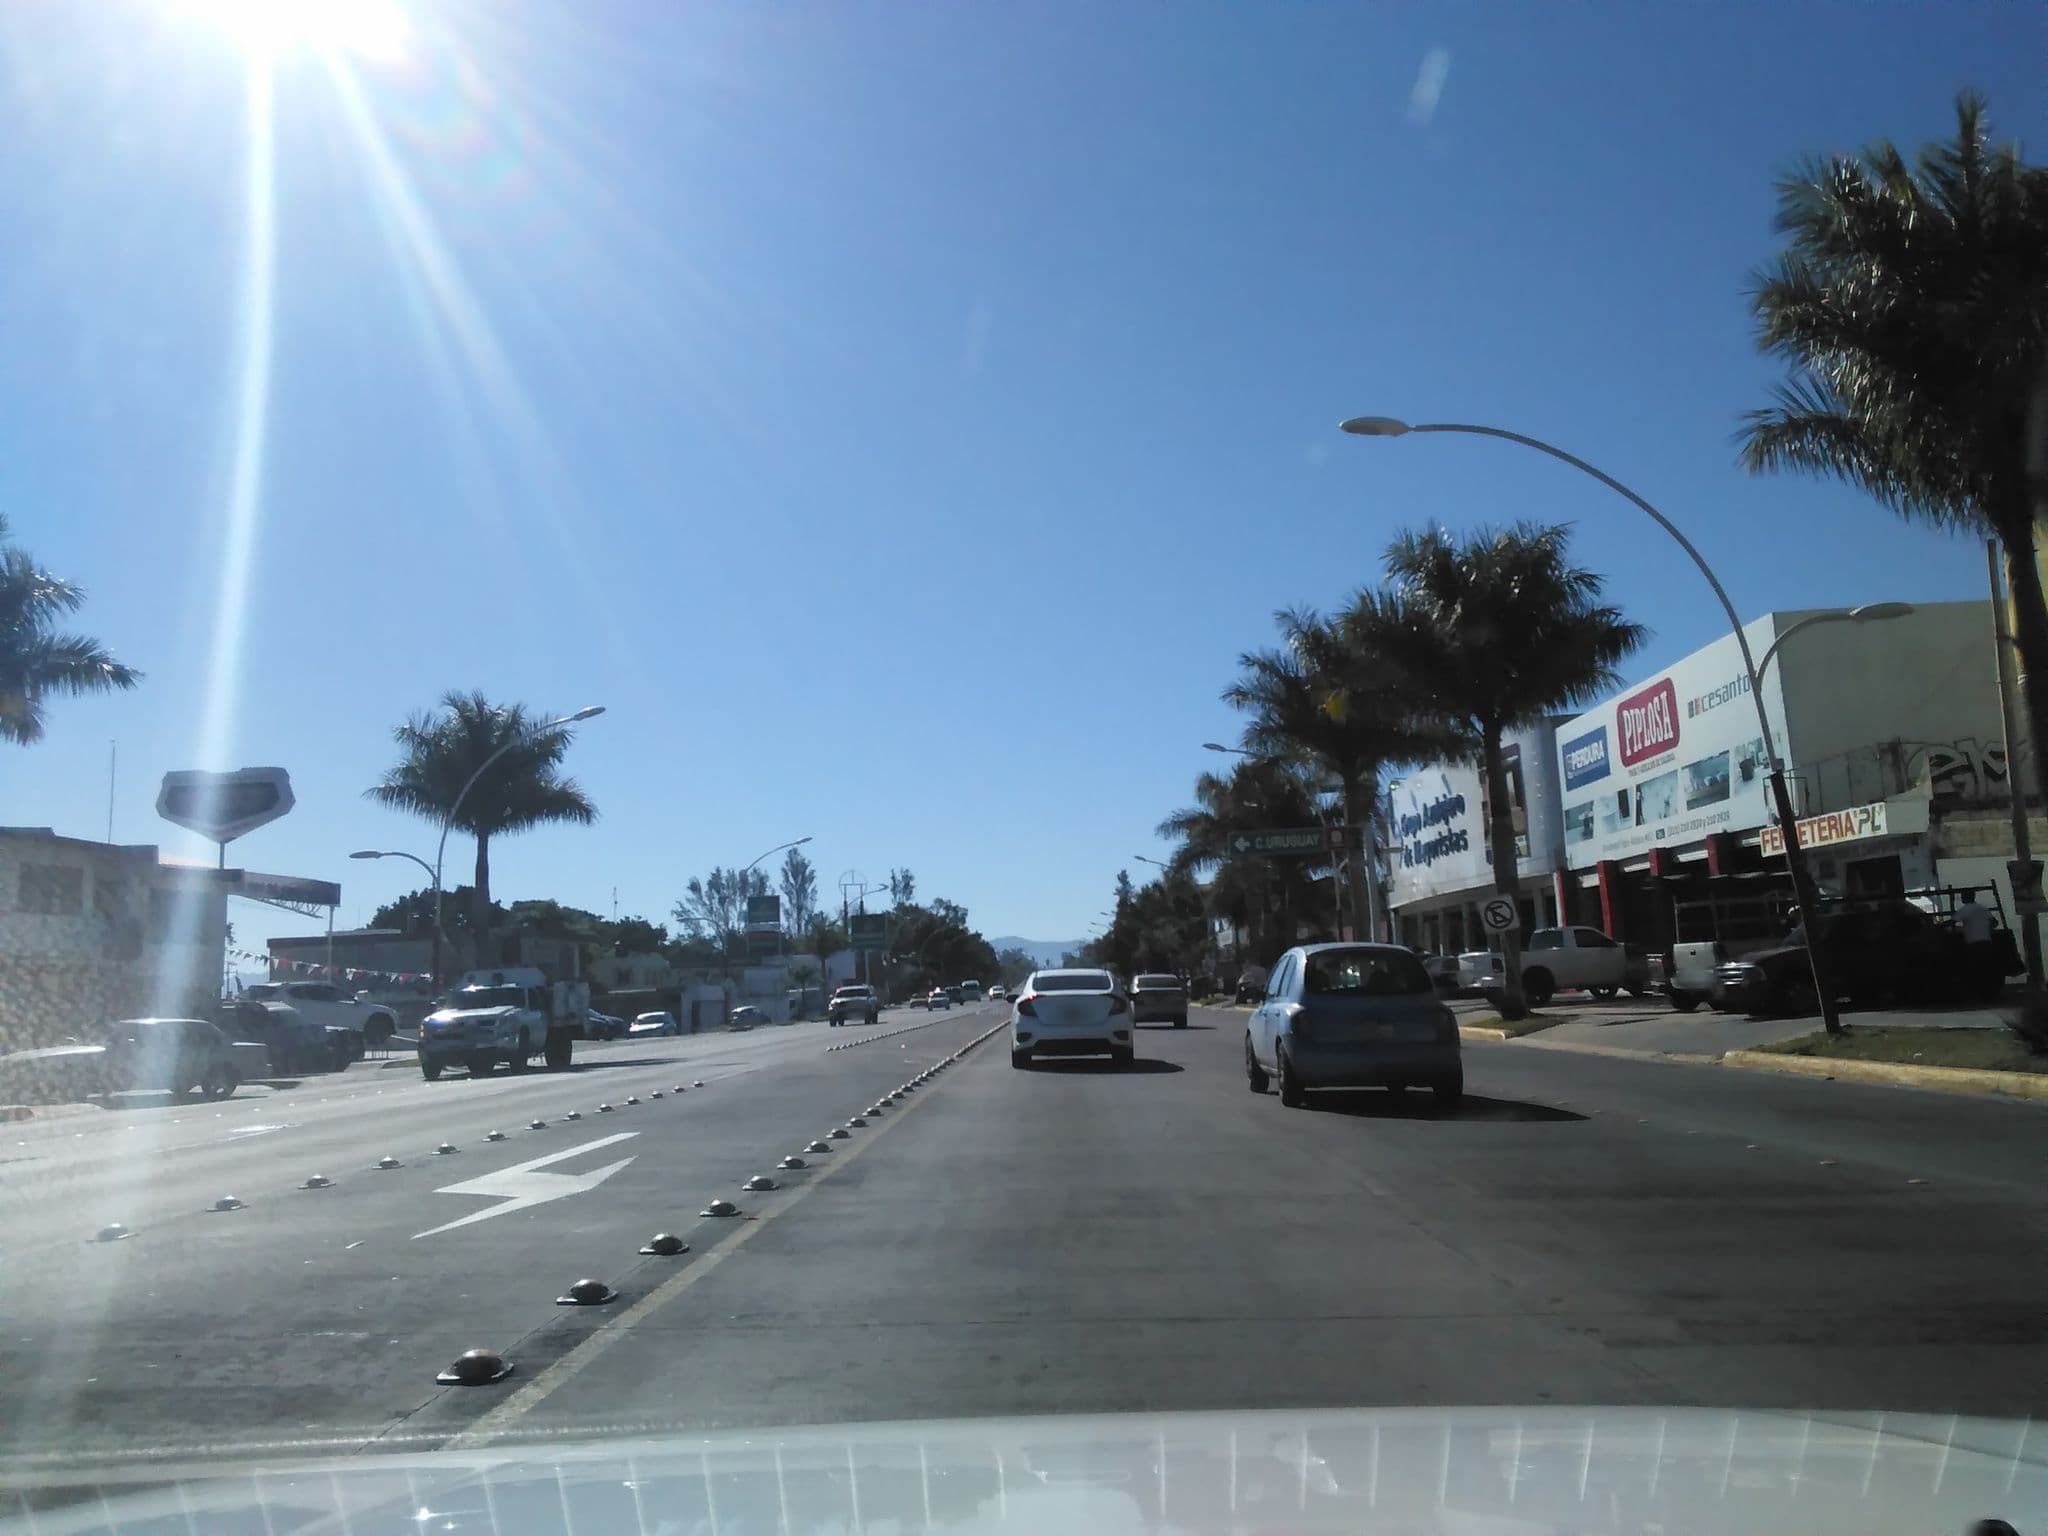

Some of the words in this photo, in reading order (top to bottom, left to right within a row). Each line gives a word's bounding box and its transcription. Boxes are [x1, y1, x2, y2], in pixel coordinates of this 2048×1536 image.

[1702, 673, 1751, 713] cesanto
[1623, 690, 1674, 757] PIPLOSA
[1571, 740, 1605, 770] PERDURA
[1761, 811, 1856, 853] FERETERIA
